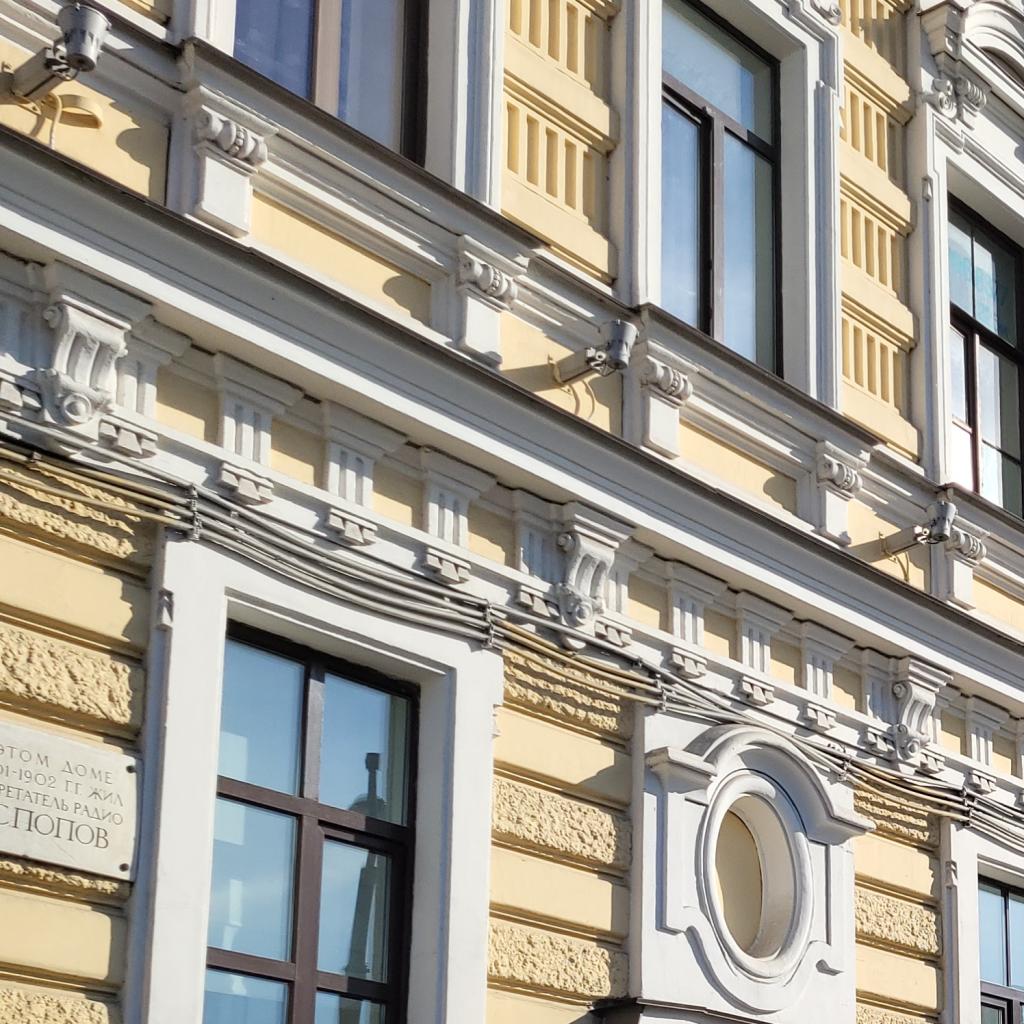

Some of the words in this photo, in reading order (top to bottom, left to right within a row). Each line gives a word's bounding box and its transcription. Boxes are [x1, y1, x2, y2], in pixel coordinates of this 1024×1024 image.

[61, 760, 113, 785] ДОМЕ
[88, 786, 124, 807] ЖИЛ
[73, 802, 123, 825] РАДИО
